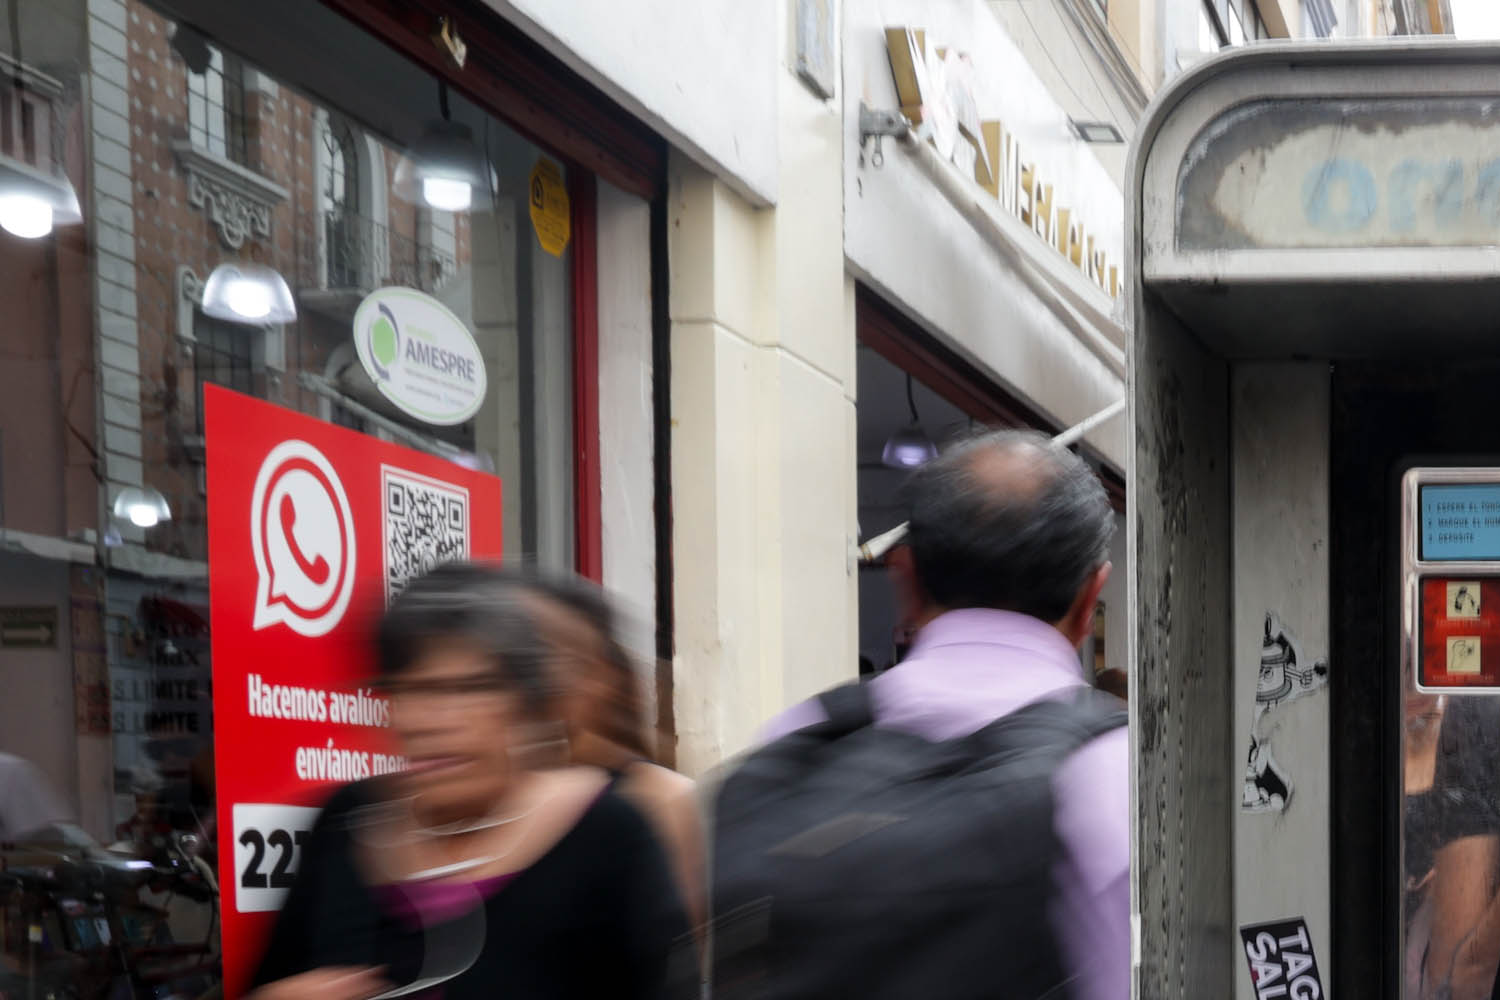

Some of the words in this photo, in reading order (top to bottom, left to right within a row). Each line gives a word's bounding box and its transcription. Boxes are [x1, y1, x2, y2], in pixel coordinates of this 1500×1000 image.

[405, 336, 475, 382] AMESPRE
[247, 673, 326, 722] Hacemos
[329, 688, 390, 728] avalúos
[295, 737, 370, 782] envíanos
